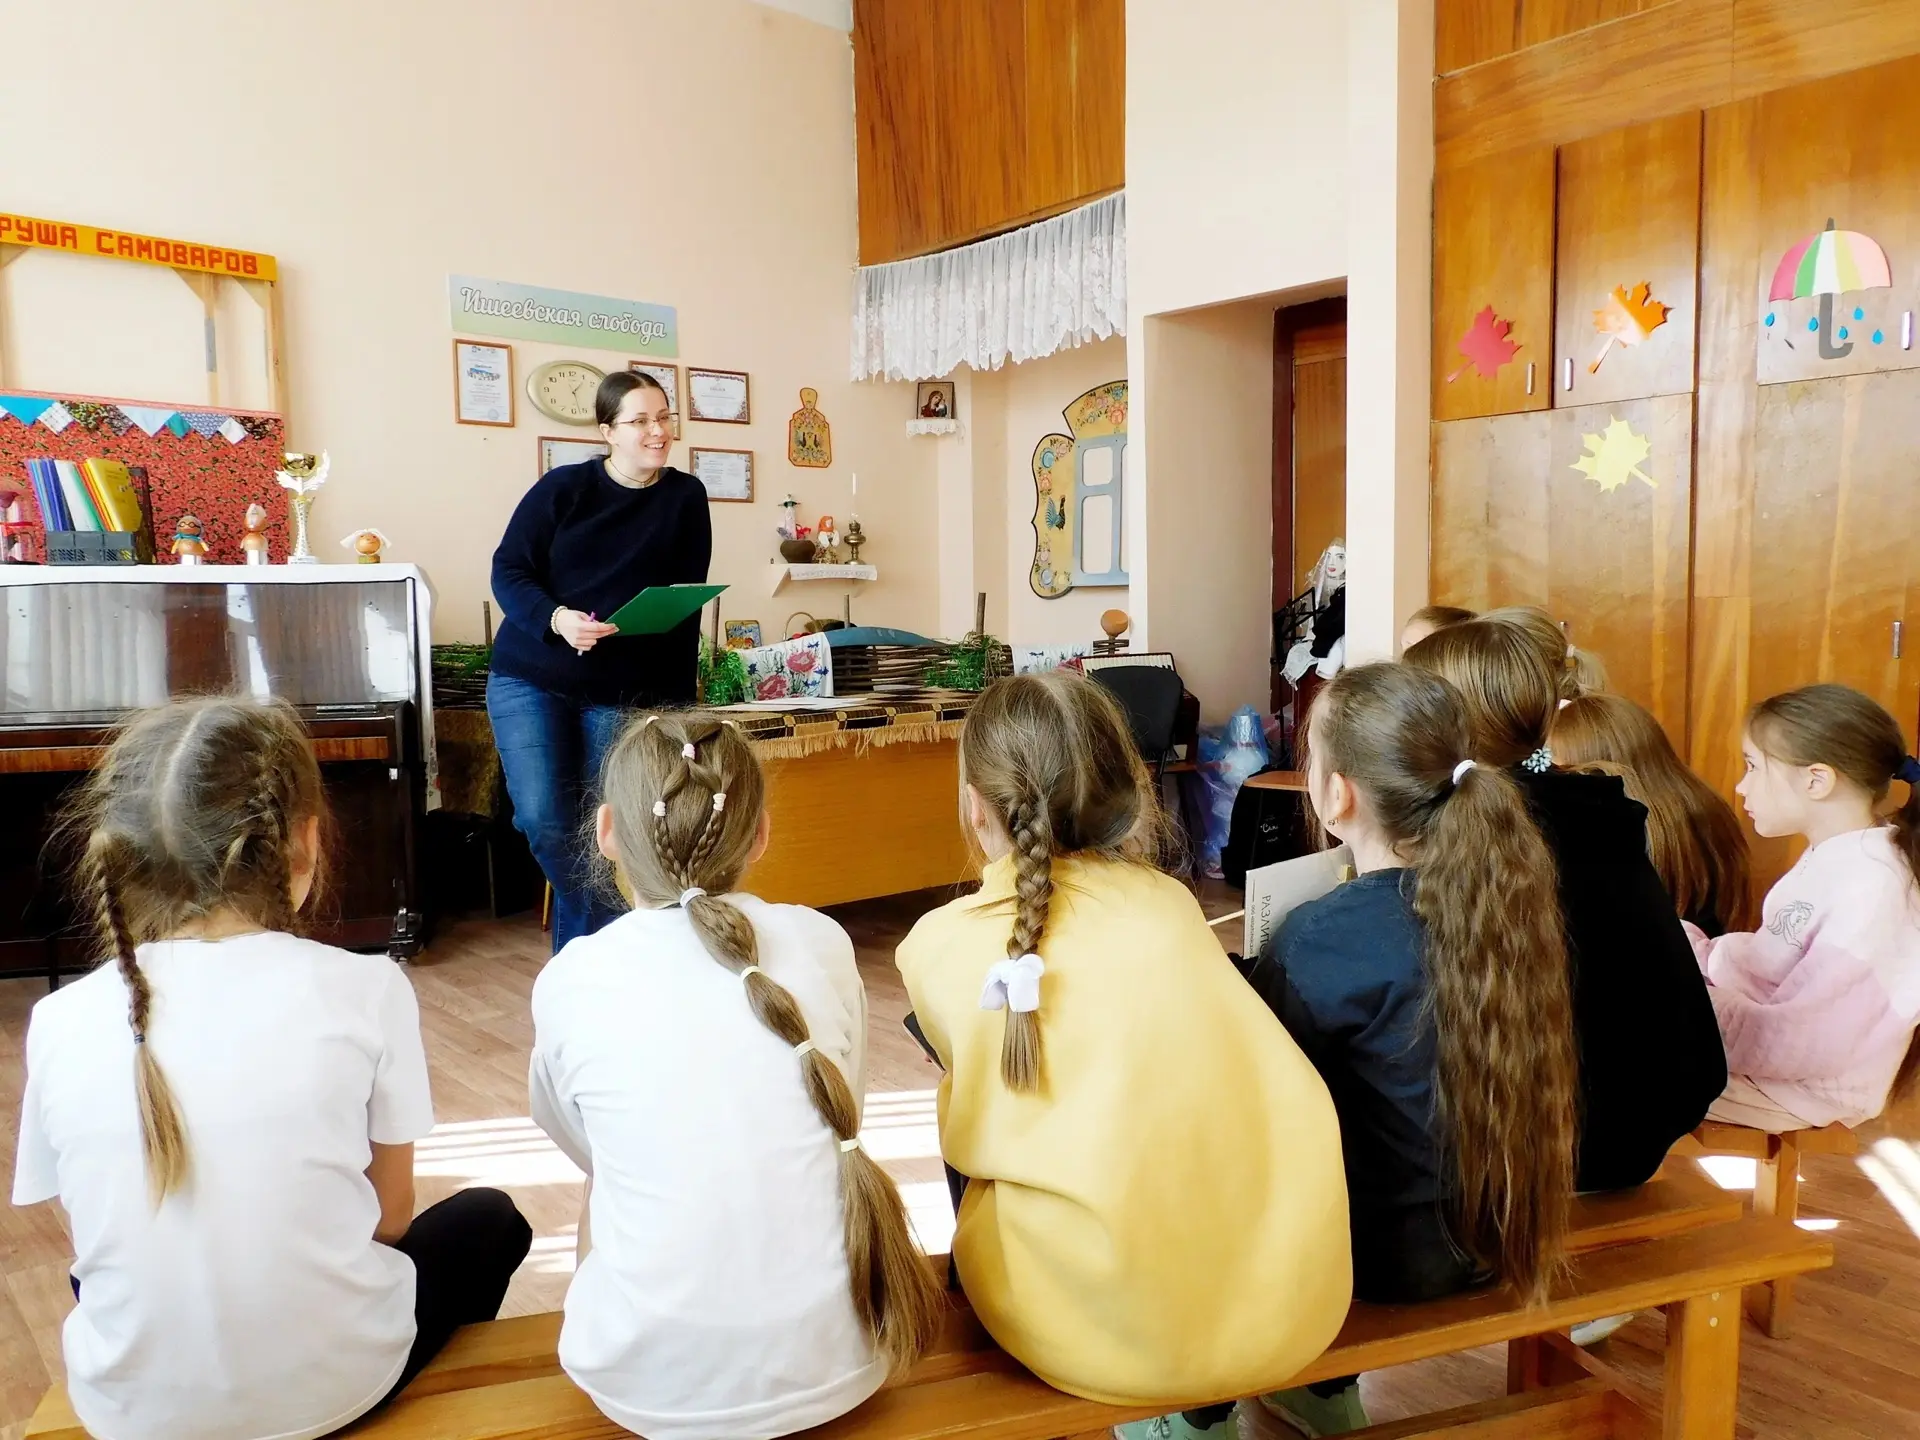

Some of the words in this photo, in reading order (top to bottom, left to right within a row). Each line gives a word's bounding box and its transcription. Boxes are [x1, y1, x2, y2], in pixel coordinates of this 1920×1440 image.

[96, 231, 258, 275] САМОВАРОВ
[460, 287, 583, 328] Ишеевская
[588, 312, 667, 345] слобода
